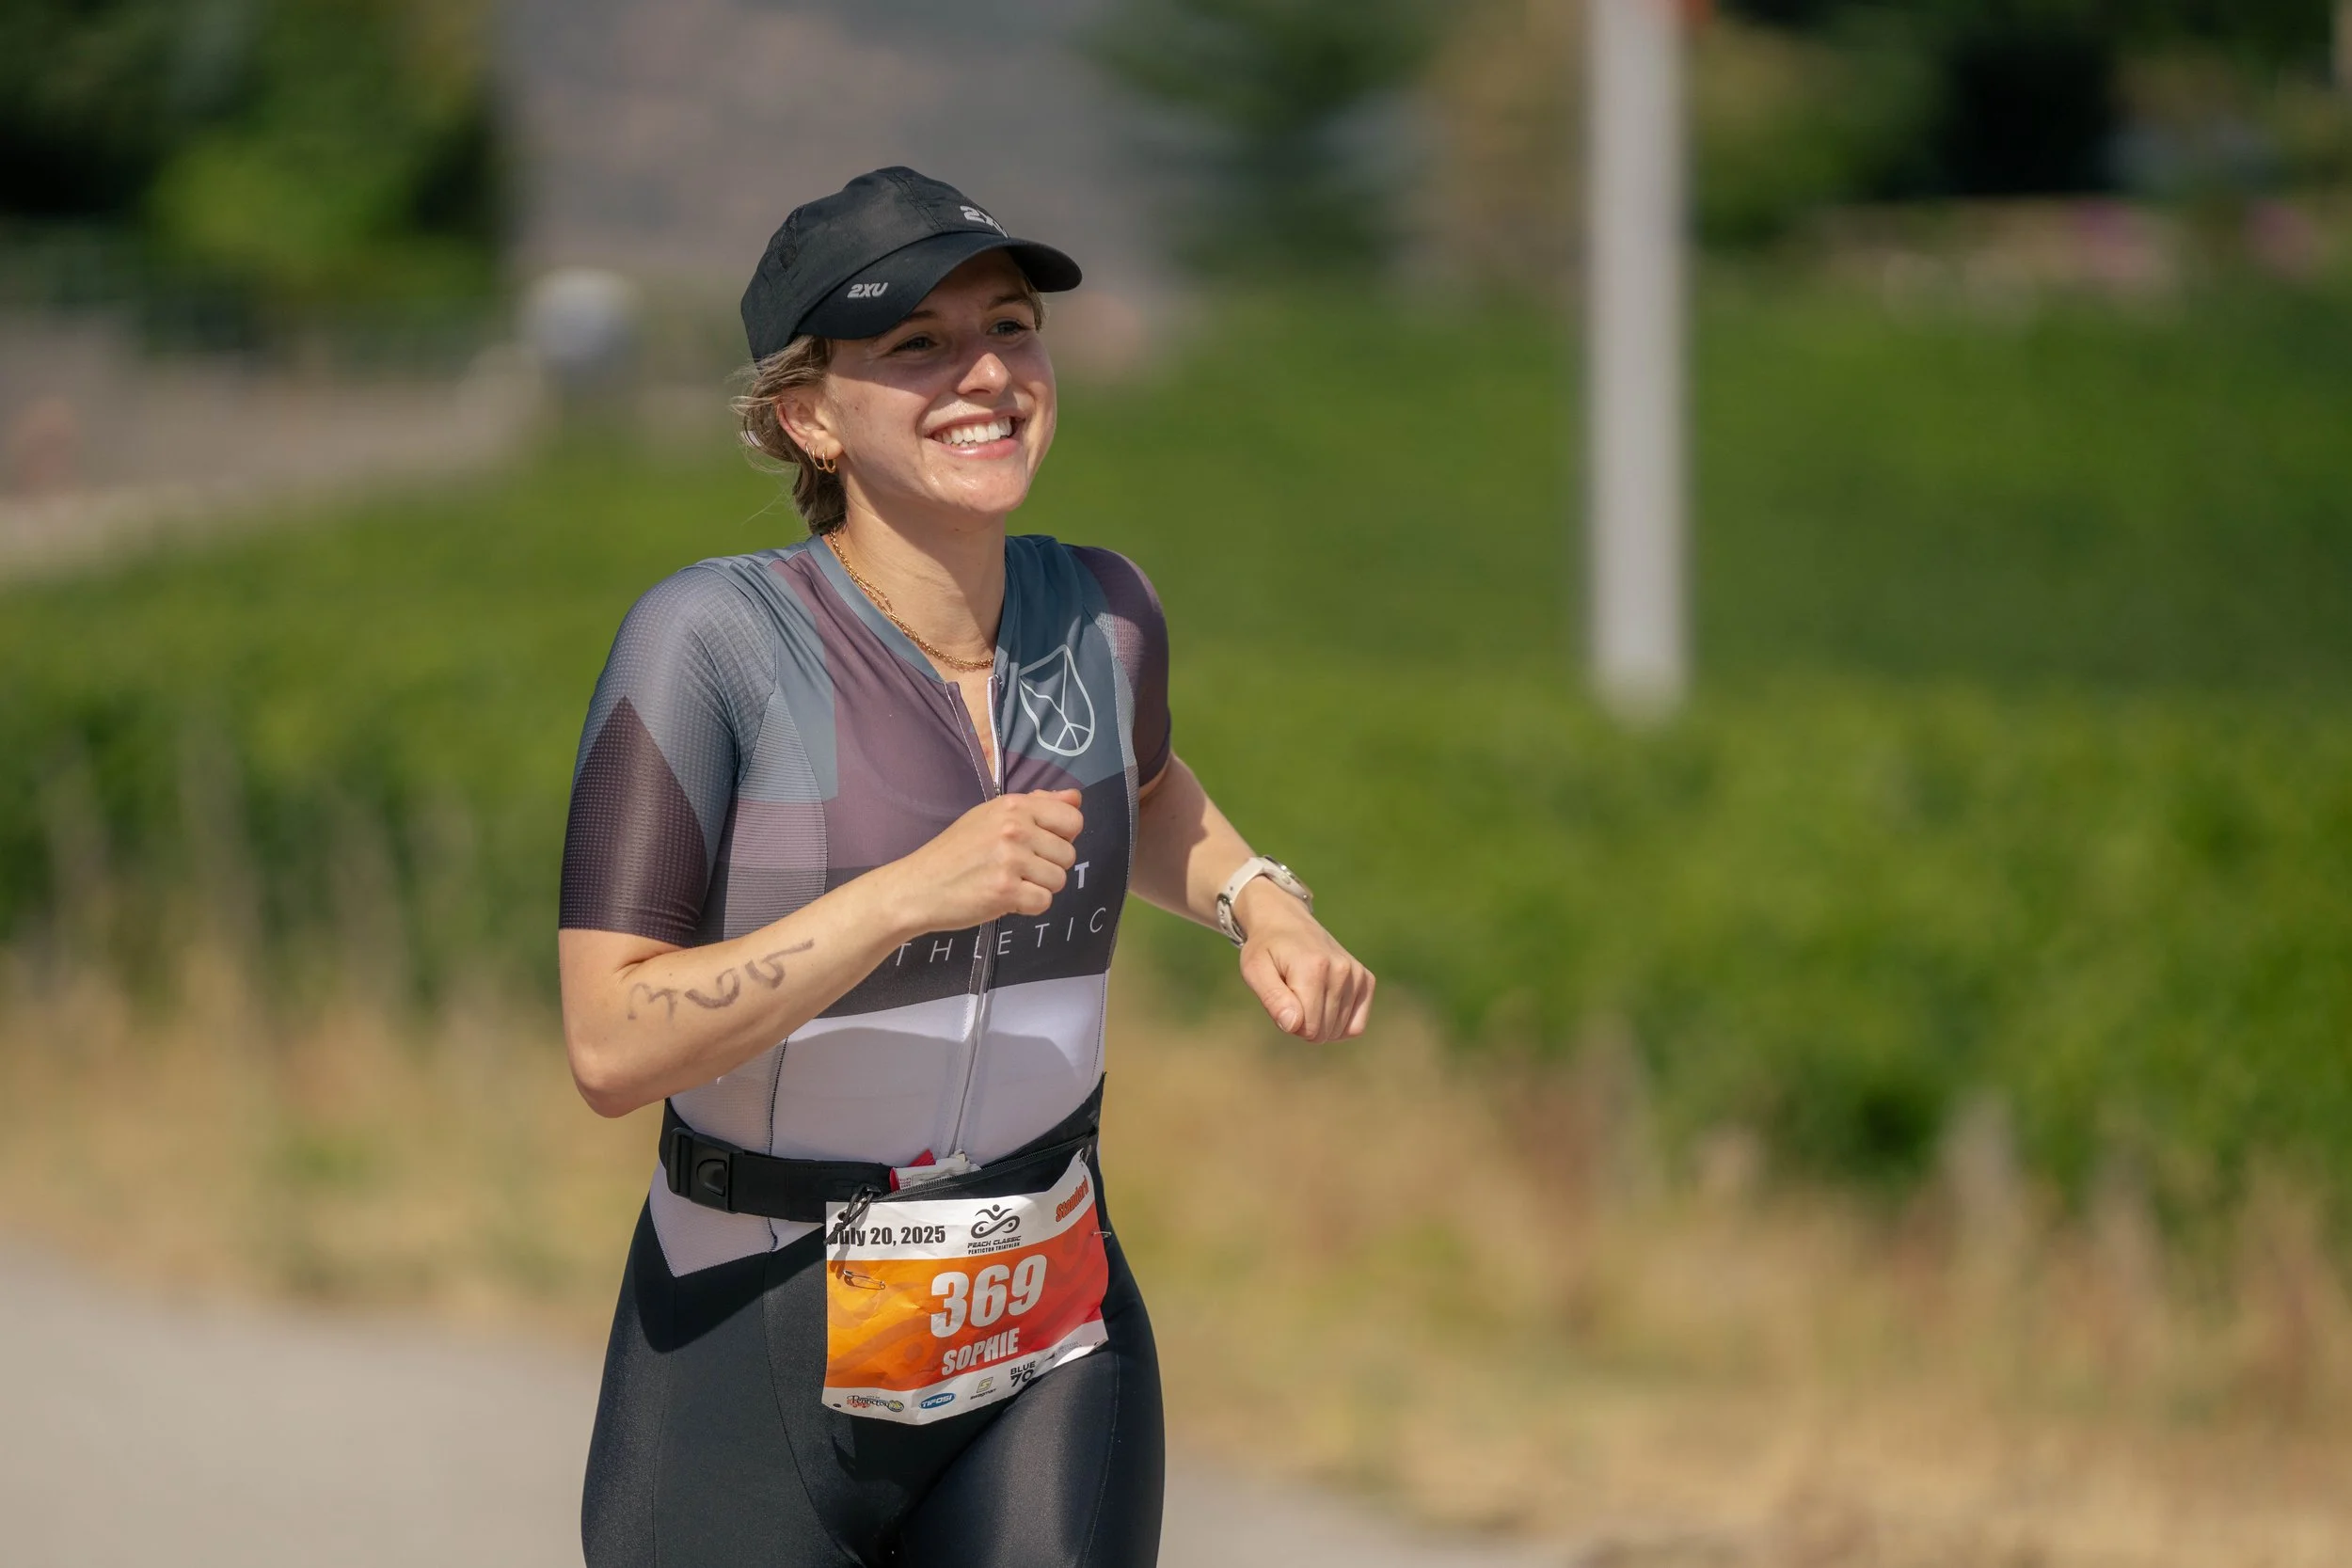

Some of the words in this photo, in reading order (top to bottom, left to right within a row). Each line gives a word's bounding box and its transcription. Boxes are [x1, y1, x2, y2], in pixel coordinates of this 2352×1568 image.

[847, 282, 888, 298] 2XU
[896, 907, 1106, 967] THLETIC
[870, 1227, 897, 1246] 20,
[900, 1226, 946, 1244] 2025
[967, 1240, 992, 1248] PEACH
[993, 1235, 1022, 1245] CLASSIC
[968, 1246, 994, 1255] PENTICTON
[995, 1242, 1021, 1251] TRIATHLON
[930, 1255, 1047, 1338] 369
[941, 1327, 1020, 1377] SOPHIE
[1010, 1360, 1036, 1375] BLUE
[1010, 1369, 1034, 1387] 70
[922, 1394, 953, 1407] TIFOSI
